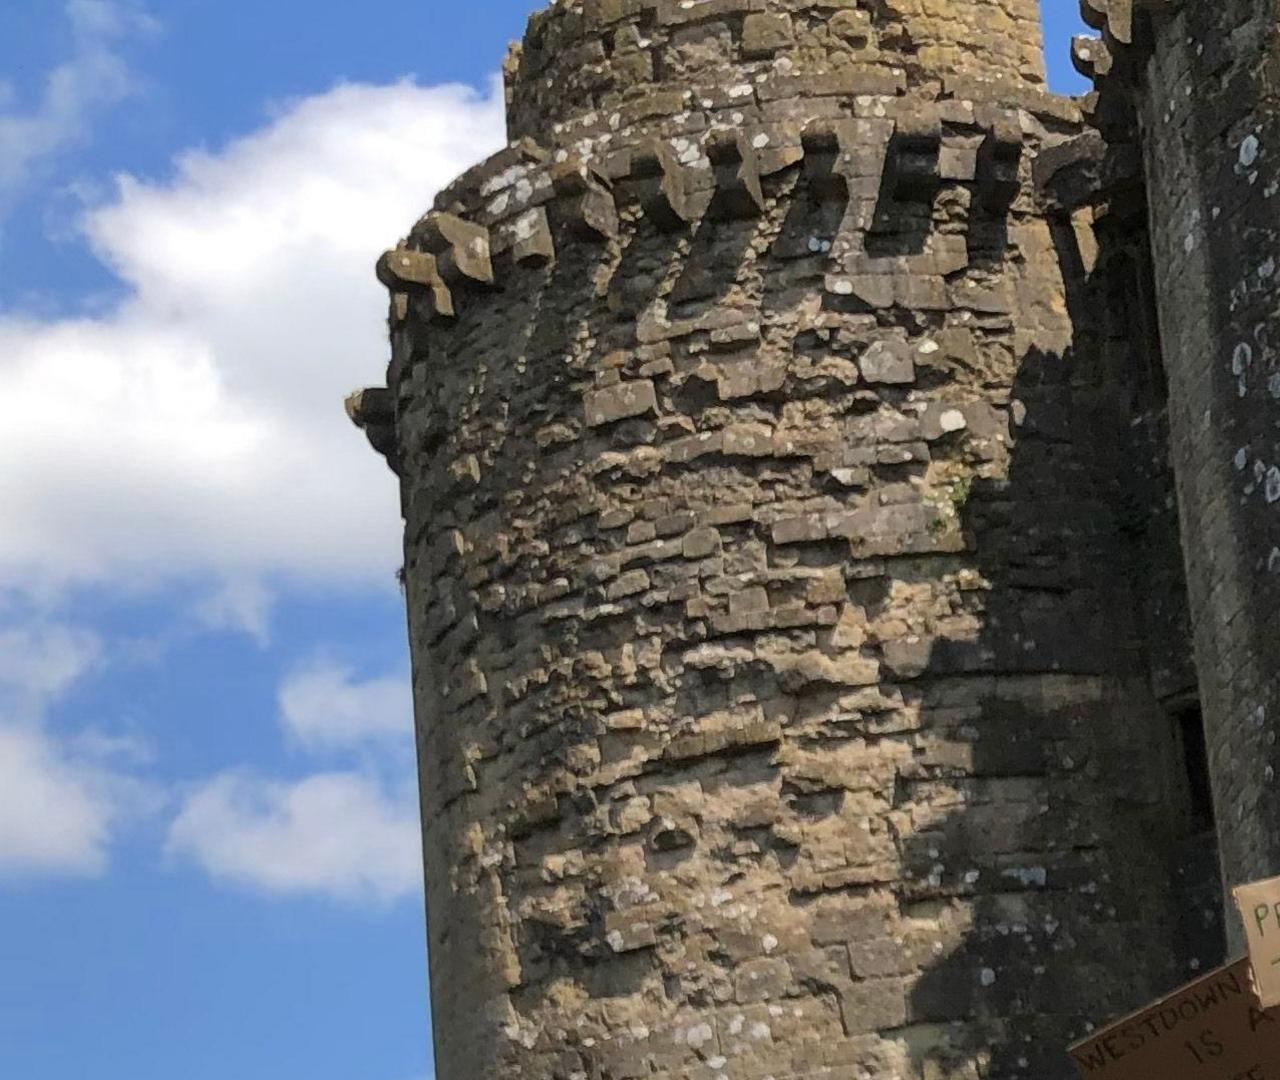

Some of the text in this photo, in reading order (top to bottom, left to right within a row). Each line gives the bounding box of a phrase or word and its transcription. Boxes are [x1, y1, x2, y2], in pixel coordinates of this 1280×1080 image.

[1076, 971, 1245, 1073] WESTDOWN
[1184, 1005, 1276, 1065] IS A
